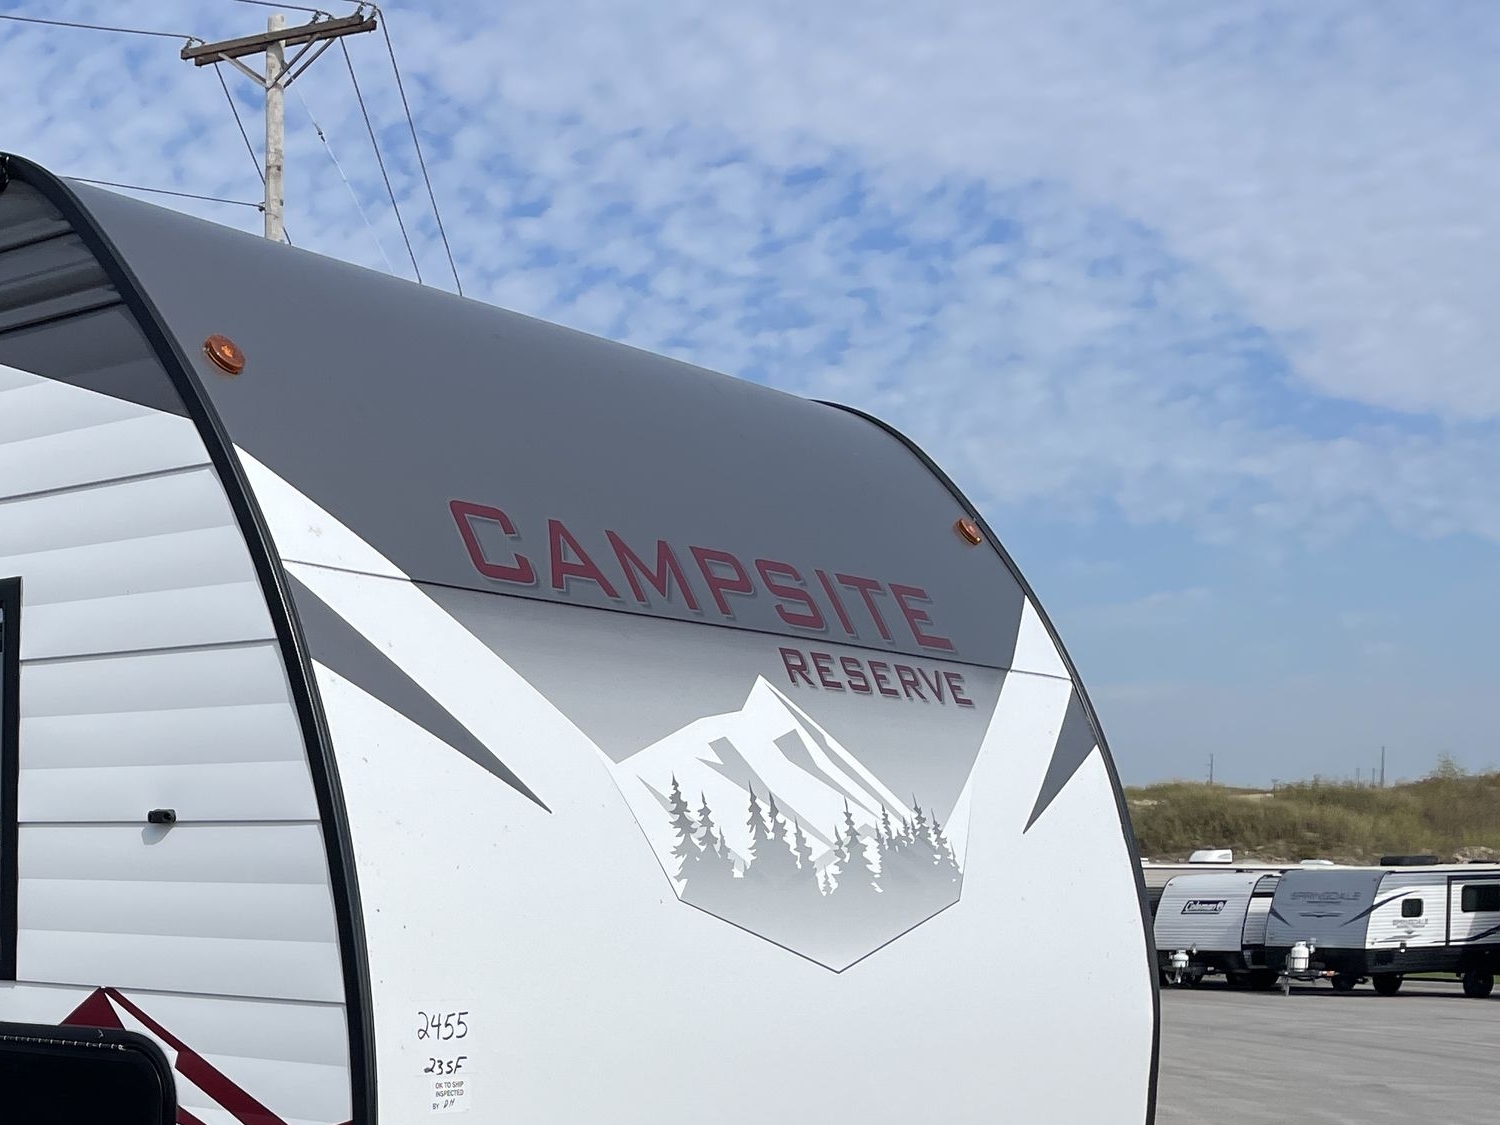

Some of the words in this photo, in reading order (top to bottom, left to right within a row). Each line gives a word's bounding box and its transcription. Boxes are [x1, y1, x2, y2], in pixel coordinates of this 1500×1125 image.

[448, 499, 956, 653] CAMPSITE
[778, 646, 975, 708] RESERVE
[417, 1011, 469, 1041] 2455
[435, 1089, 464, 1097] INSPECTED
[452, 1080, 464, 1088] SHIP
